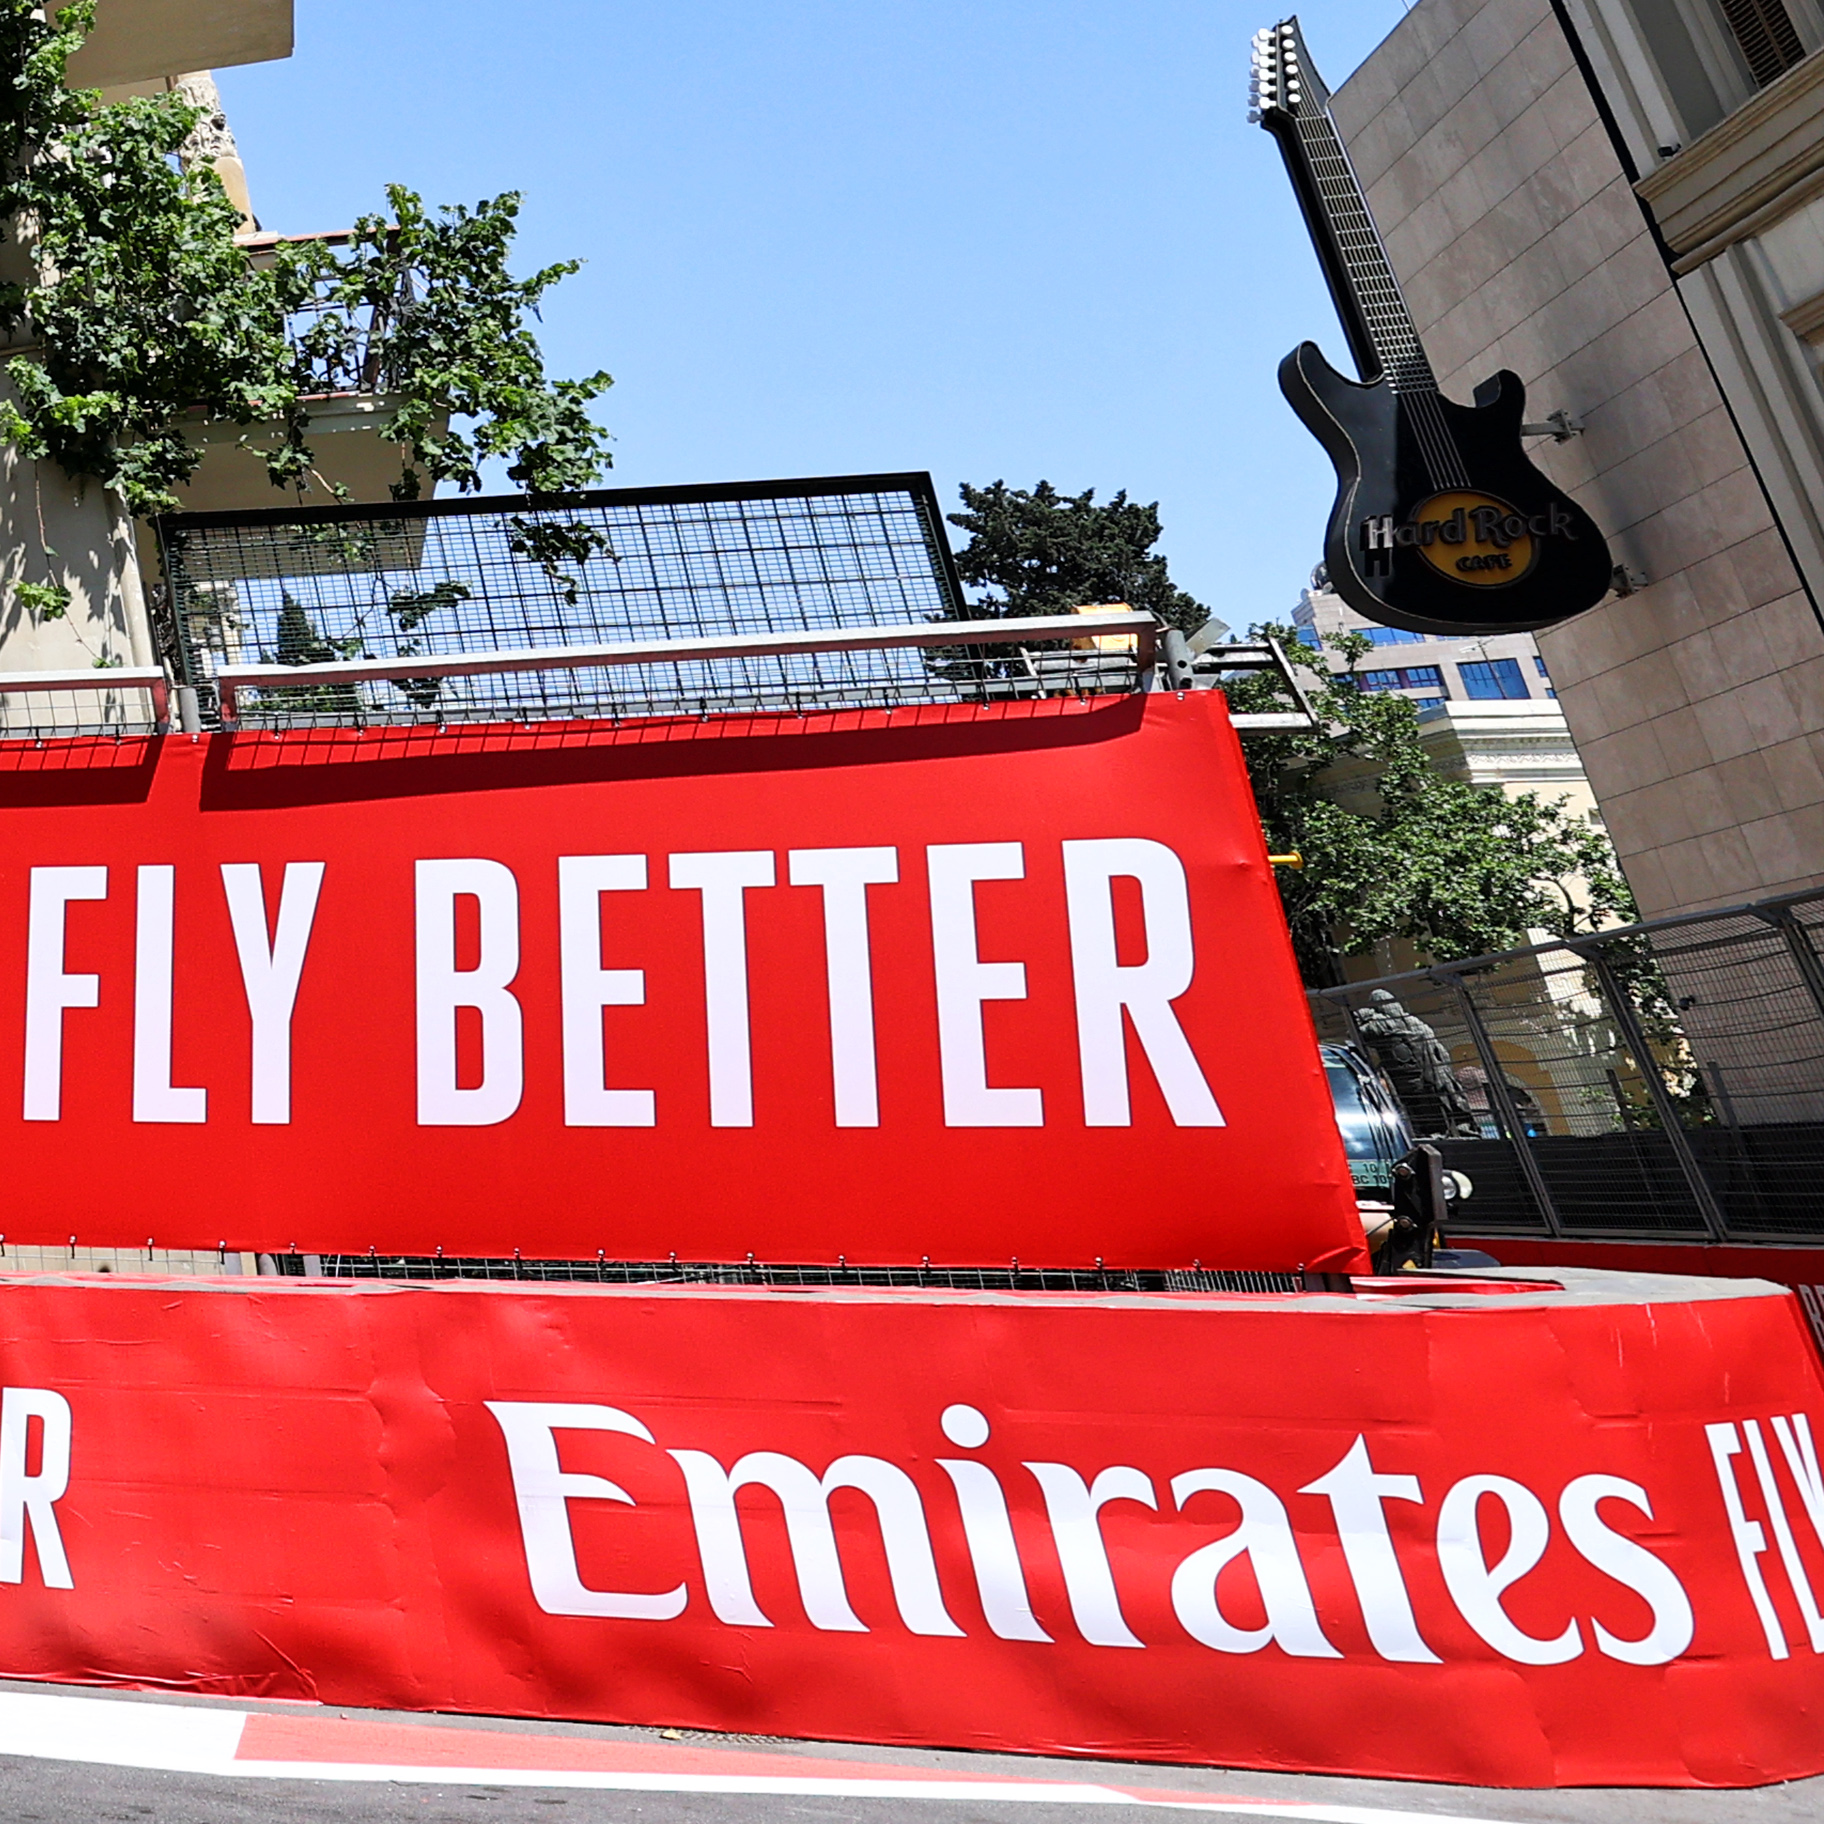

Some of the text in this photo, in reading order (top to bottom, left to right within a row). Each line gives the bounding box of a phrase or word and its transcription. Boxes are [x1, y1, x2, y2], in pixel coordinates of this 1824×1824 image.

[1362, 502, 1579, 549] Hard Rock
[1456, 553, 1512, 572] CAFE
[23, 862, 326, 1125] FLY
[414, 837, 1227, 1128] BETTER
[483, 1401, 1694, 1666] Emirates
